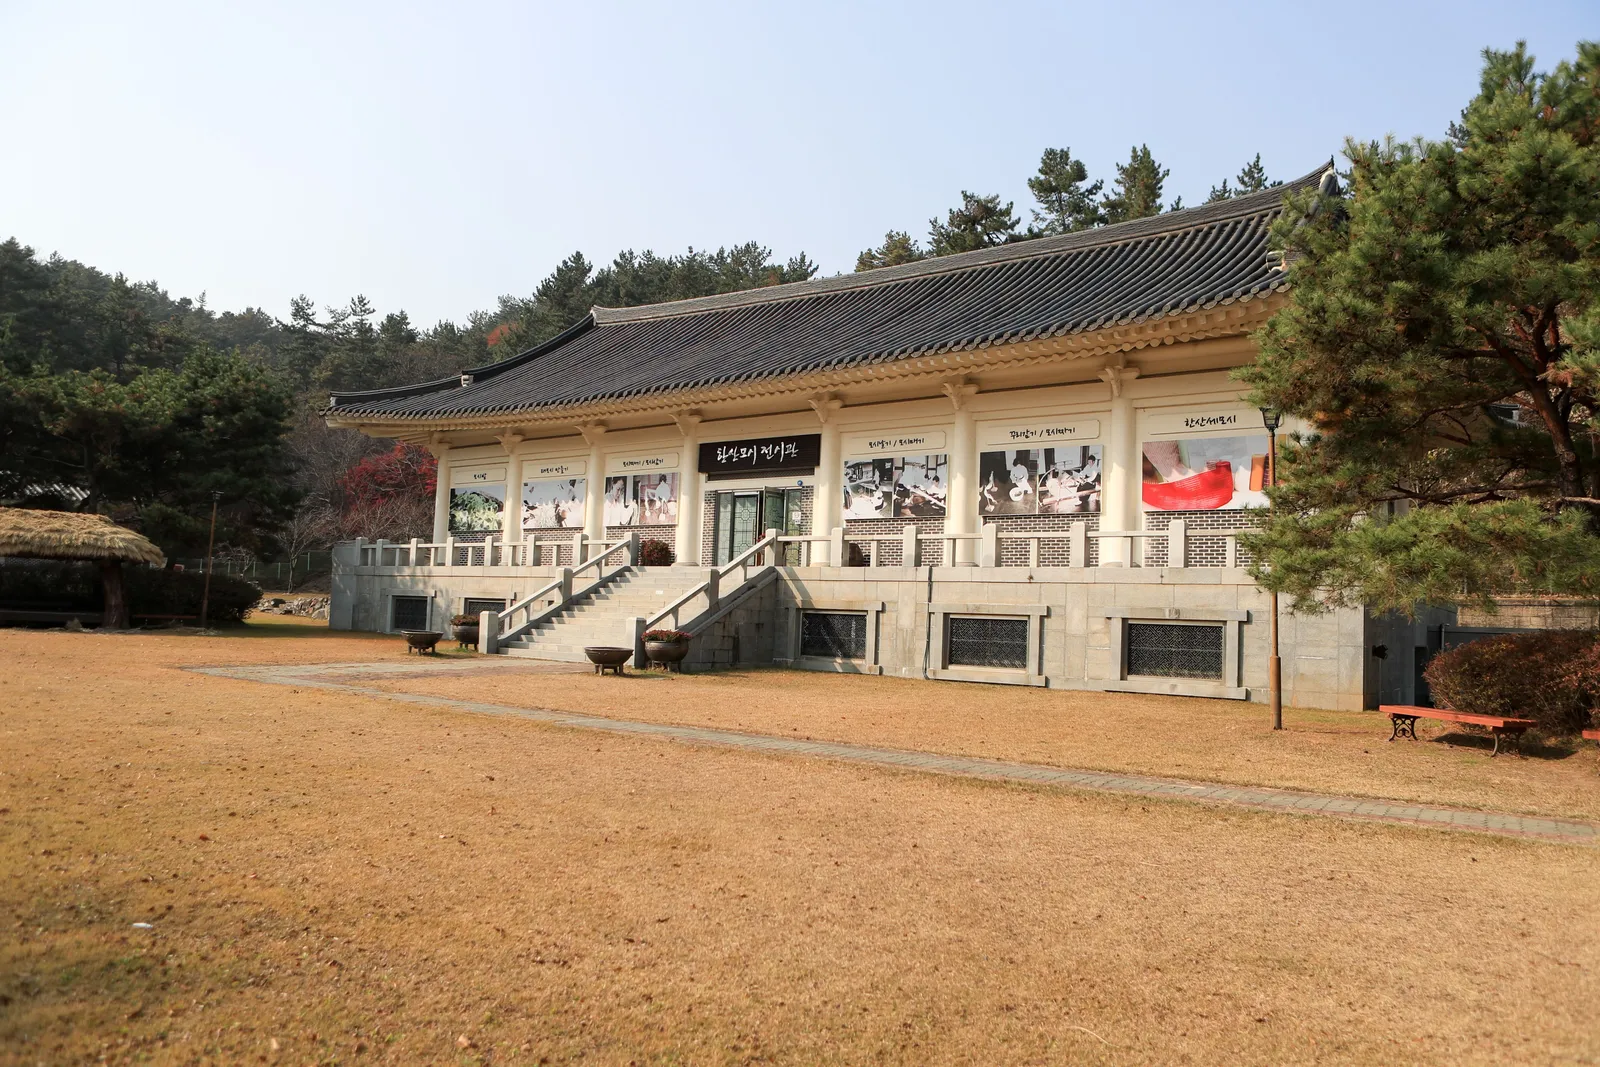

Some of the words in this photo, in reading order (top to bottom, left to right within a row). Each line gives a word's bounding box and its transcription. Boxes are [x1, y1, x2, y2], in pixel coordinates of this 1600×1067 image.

[1184, 414, 1236, 428] 한산세모시
[717, 444, 757, 465] 한산모시
[760, 441, 799, 463] 전시관
